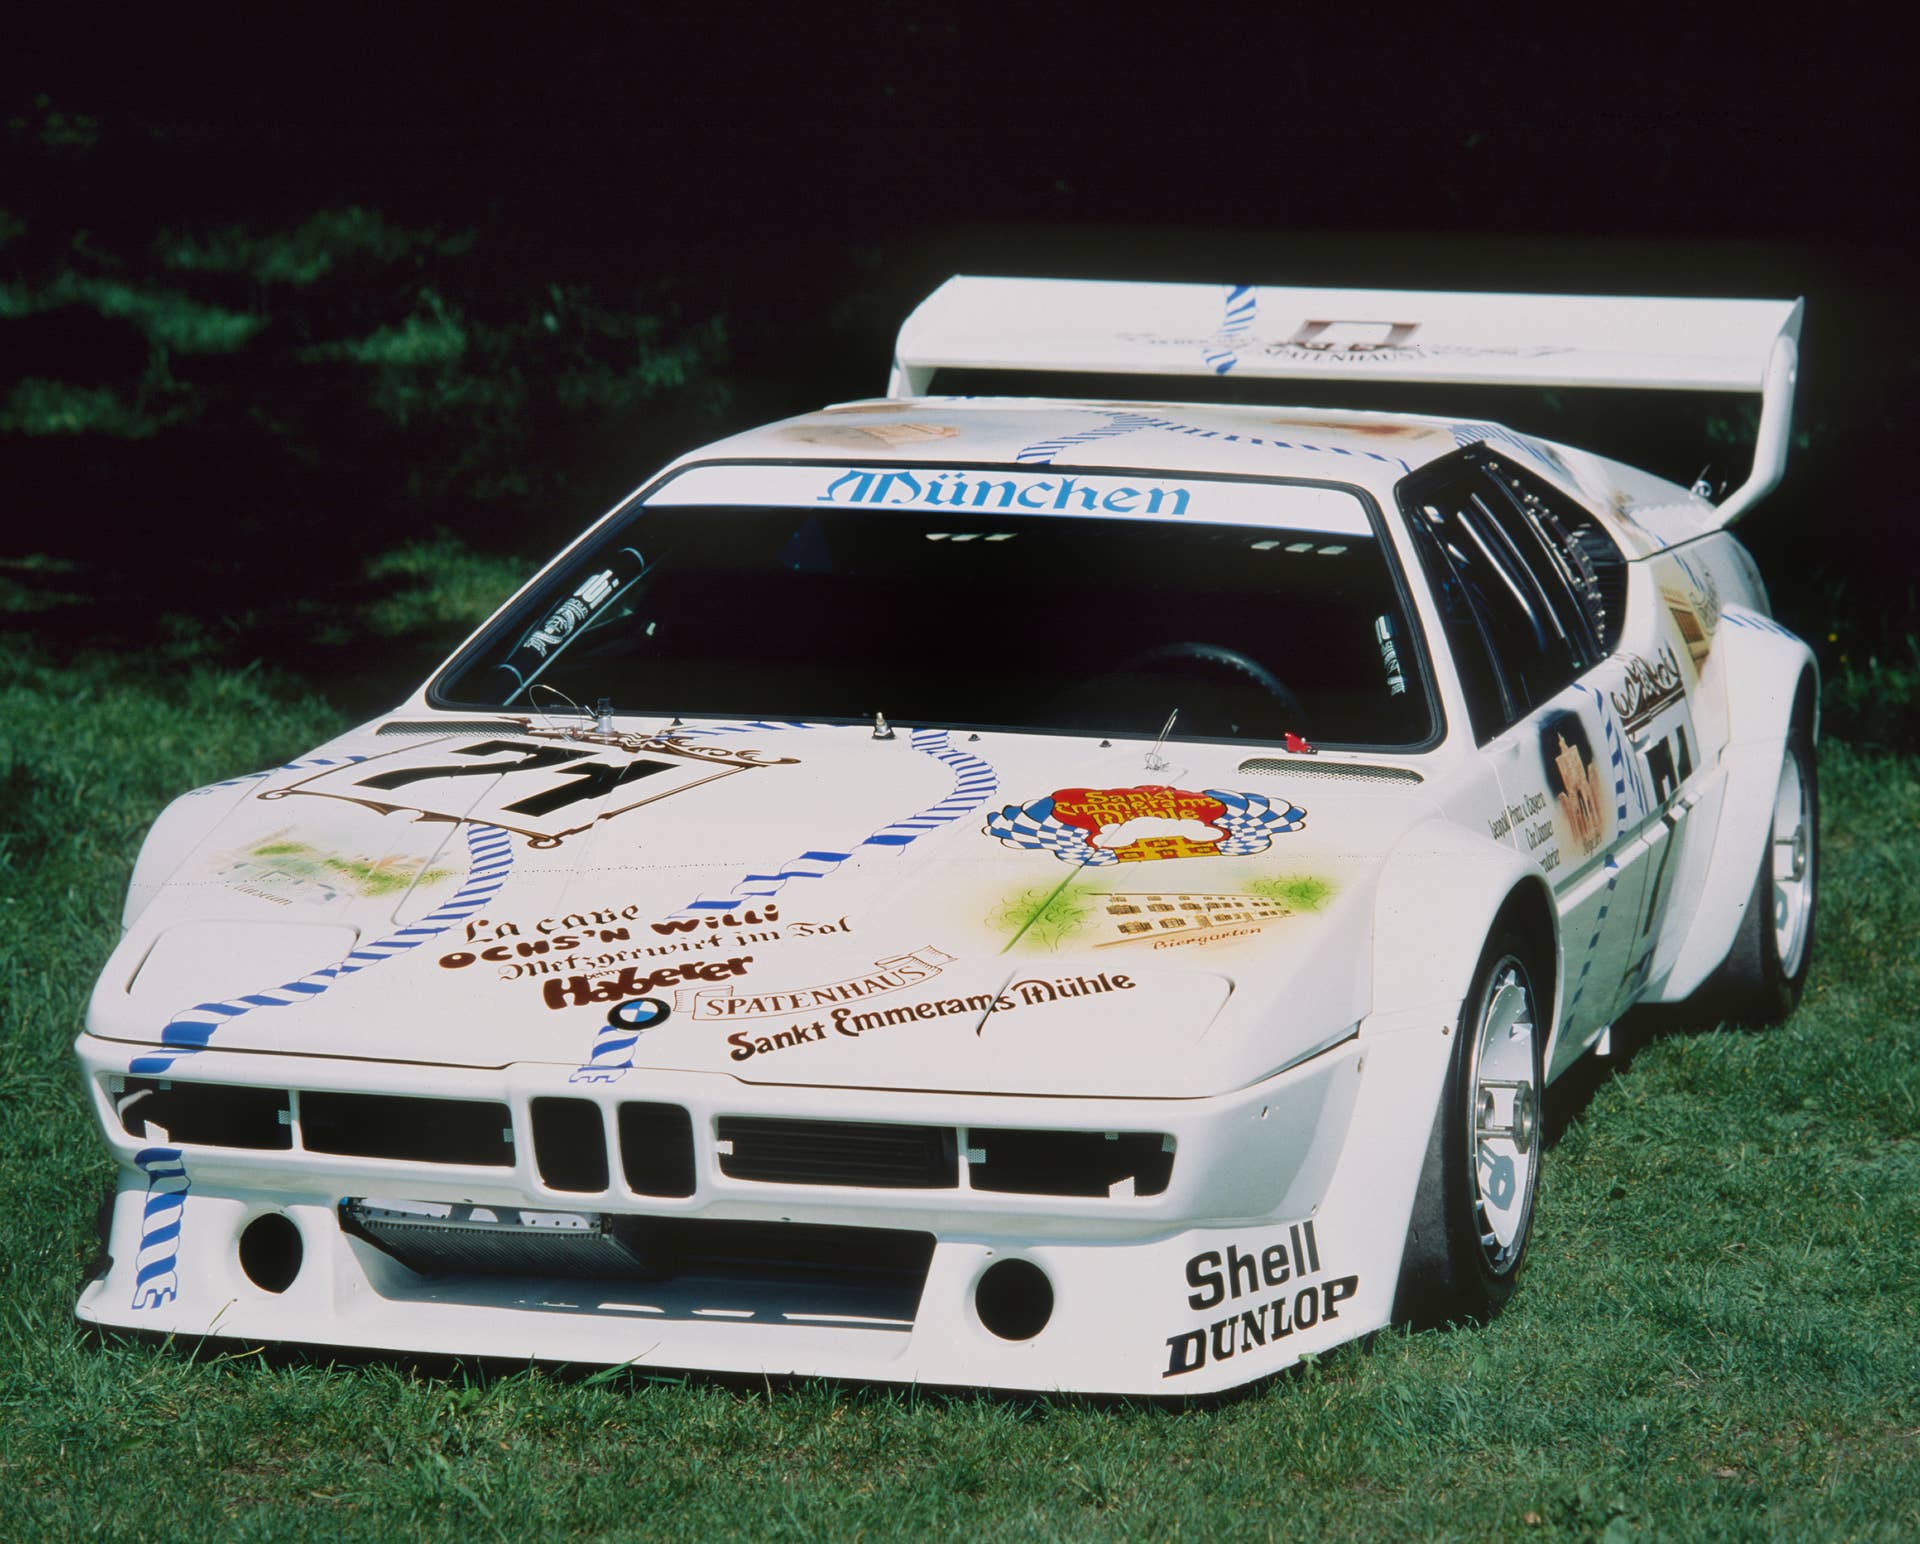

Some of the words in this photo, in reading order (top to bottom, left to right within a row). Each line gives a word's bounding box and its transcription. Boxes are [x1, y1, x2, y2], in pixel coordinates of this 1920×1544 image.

[817, 470, 1190, 515] München
[1055, 797, 1222, 816] Emmerams
[1084, 791, 1174, 804] Sankt
[439, 927, 630, 969] OCHS'N
[465, 919, 520, 944] La
[536, 905, 639, 935] cave
[498, 934, 723, 980] Metzgerwirt
[735, 931, 780, 946] im
[543, 956, 753, 1010] Haberer
[706, 965, 926, 1016] SPATENHAUS
[727, 1020, 826, 1061] Sankt
[830, 993, 1017, 1038] Emmerams
[1010, 972, 1136, 1005] Mühle
[1185, 1219, 1321, 1311] Shell
[1162, 1275, 1359, 1379] DUNLOP
